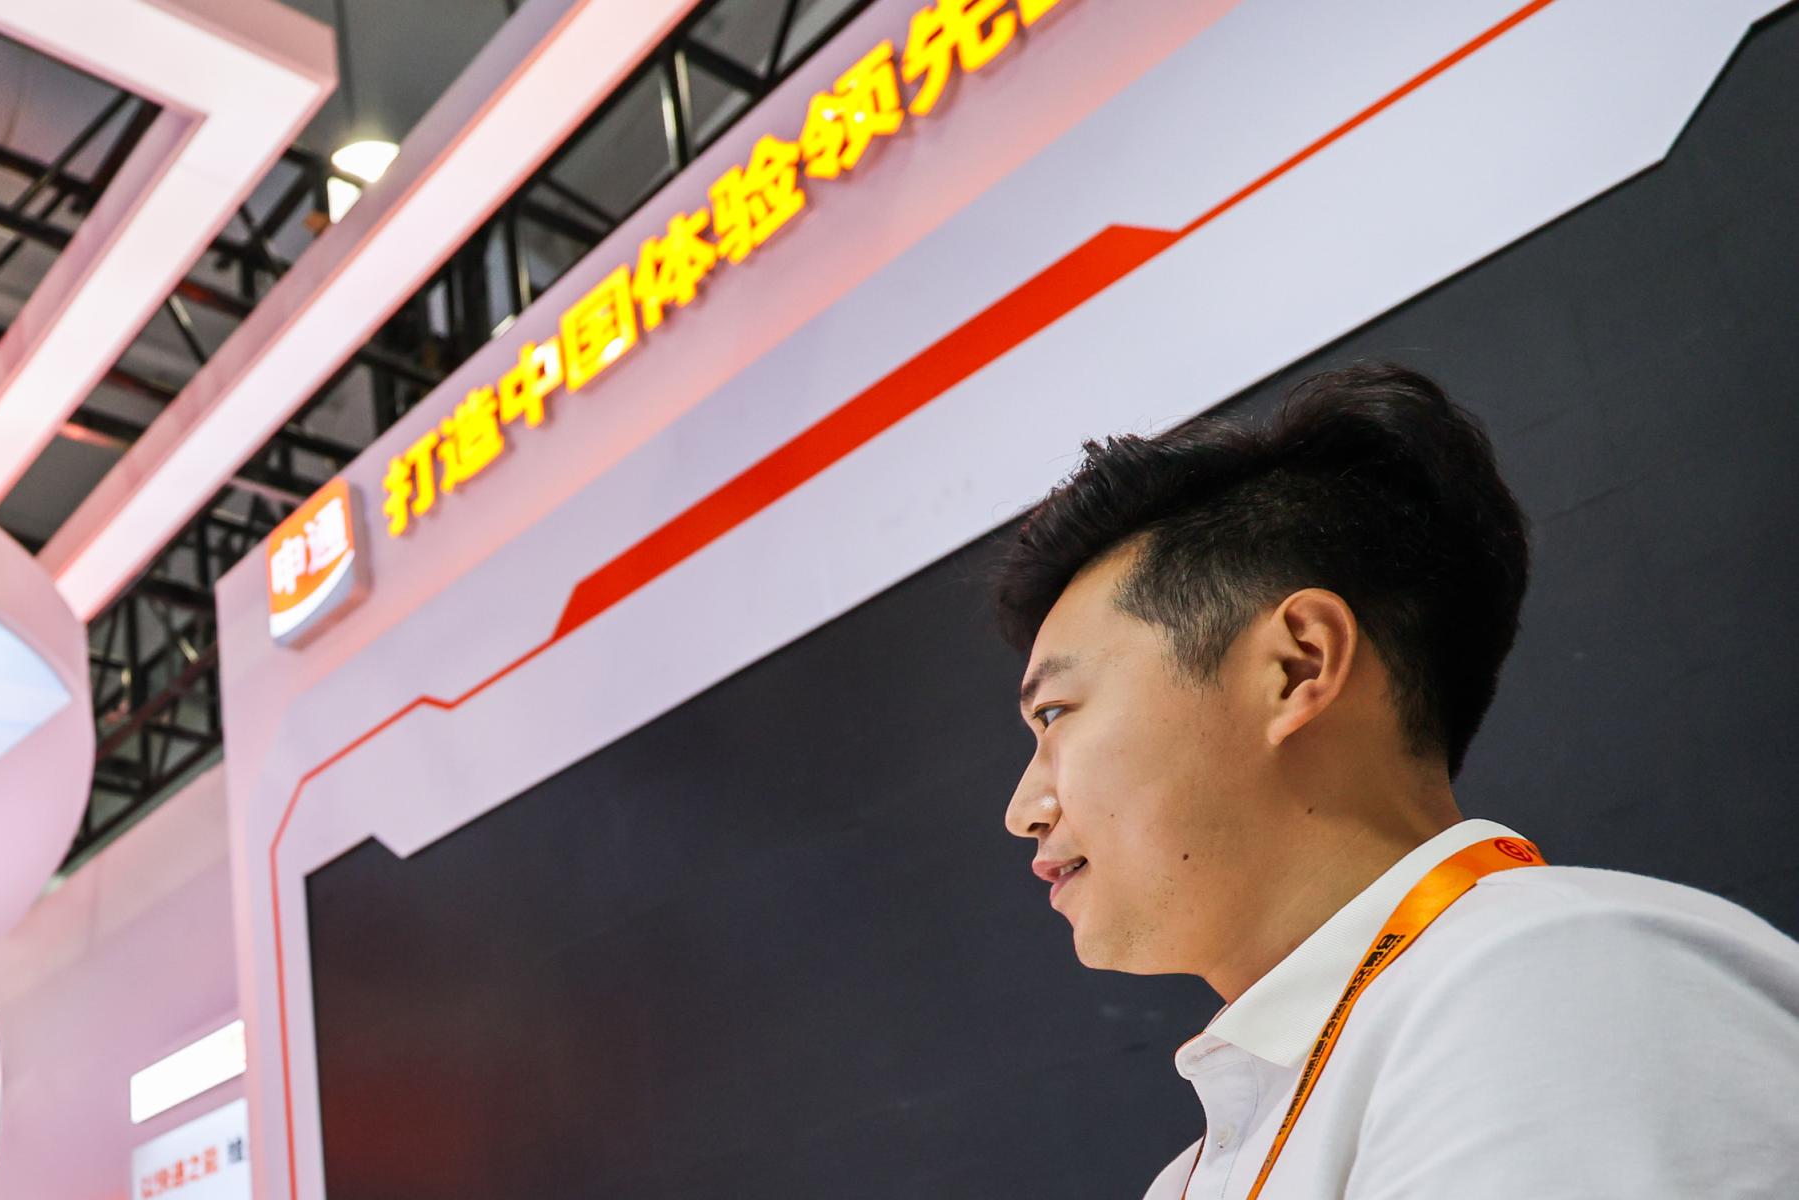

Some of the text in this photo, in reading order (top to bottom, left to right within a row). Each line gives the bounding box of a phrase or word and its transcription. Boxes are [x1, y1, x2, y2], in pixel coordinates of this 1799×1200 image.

[382, 0, 1063, 537] 打造中国体验领先
[270, 497, 348, 595] 申通
